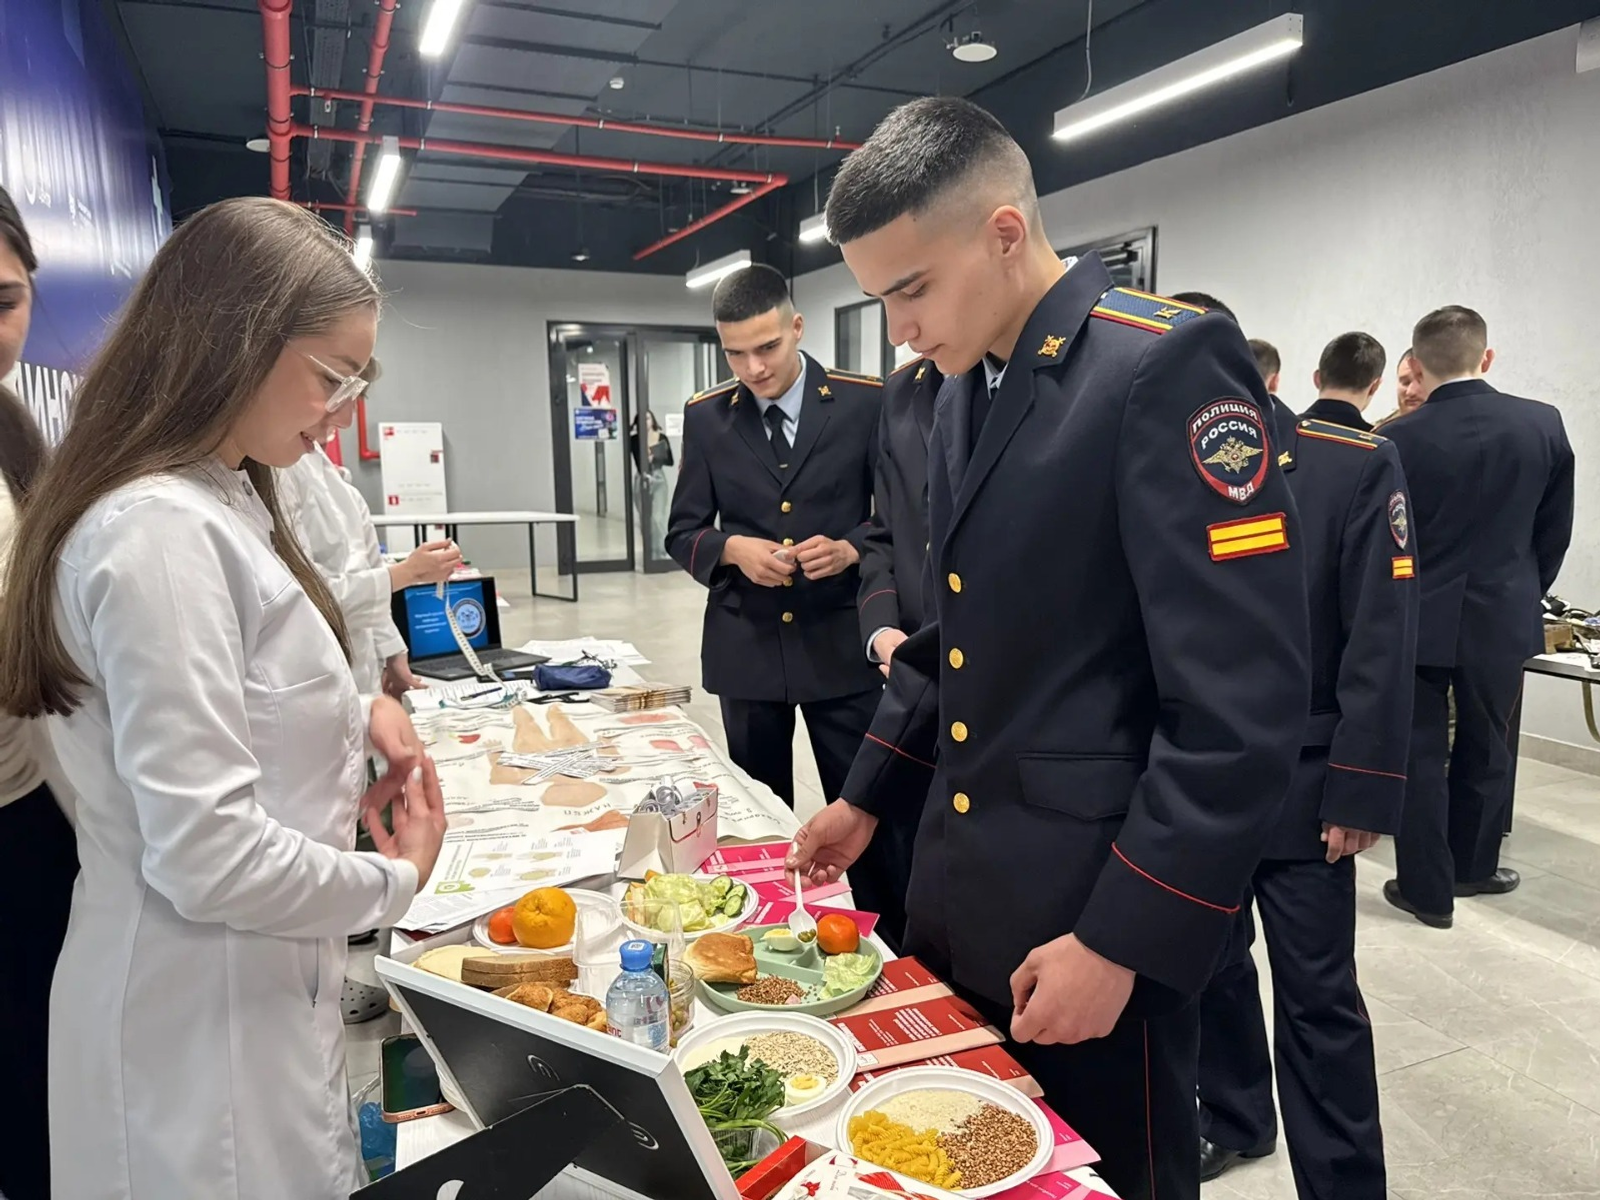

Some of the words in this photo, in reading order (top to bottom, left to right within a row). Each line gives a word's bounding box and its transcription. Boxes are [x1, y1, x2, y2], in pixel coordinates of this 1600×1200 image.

[1192, 403, 1258, 434] ПОЛИЦИЯ
[1201, 420, 1258, 450] РОССИЯ
[1227, 481, 1255, 501] МВД
